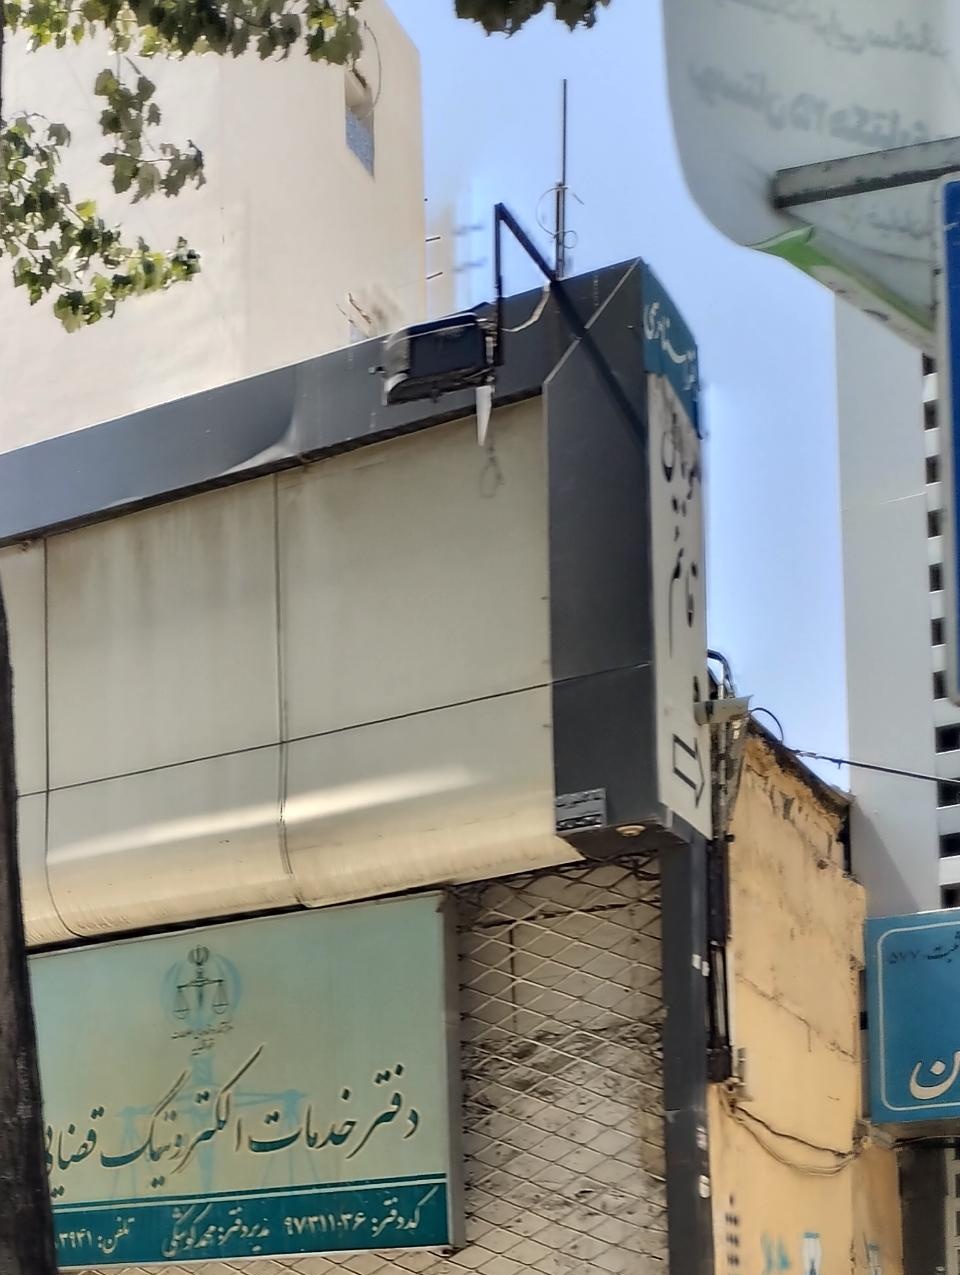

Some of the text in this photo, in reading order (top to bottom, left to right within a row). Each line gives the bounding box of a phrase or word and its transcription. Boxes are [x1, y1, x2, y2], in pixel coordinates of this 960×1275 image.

[100, 1044, 265, 1188] الکترونیک
[248, 1088, 357, 1153] خدمات
[345, 1064, 418, 1159] دفتر
